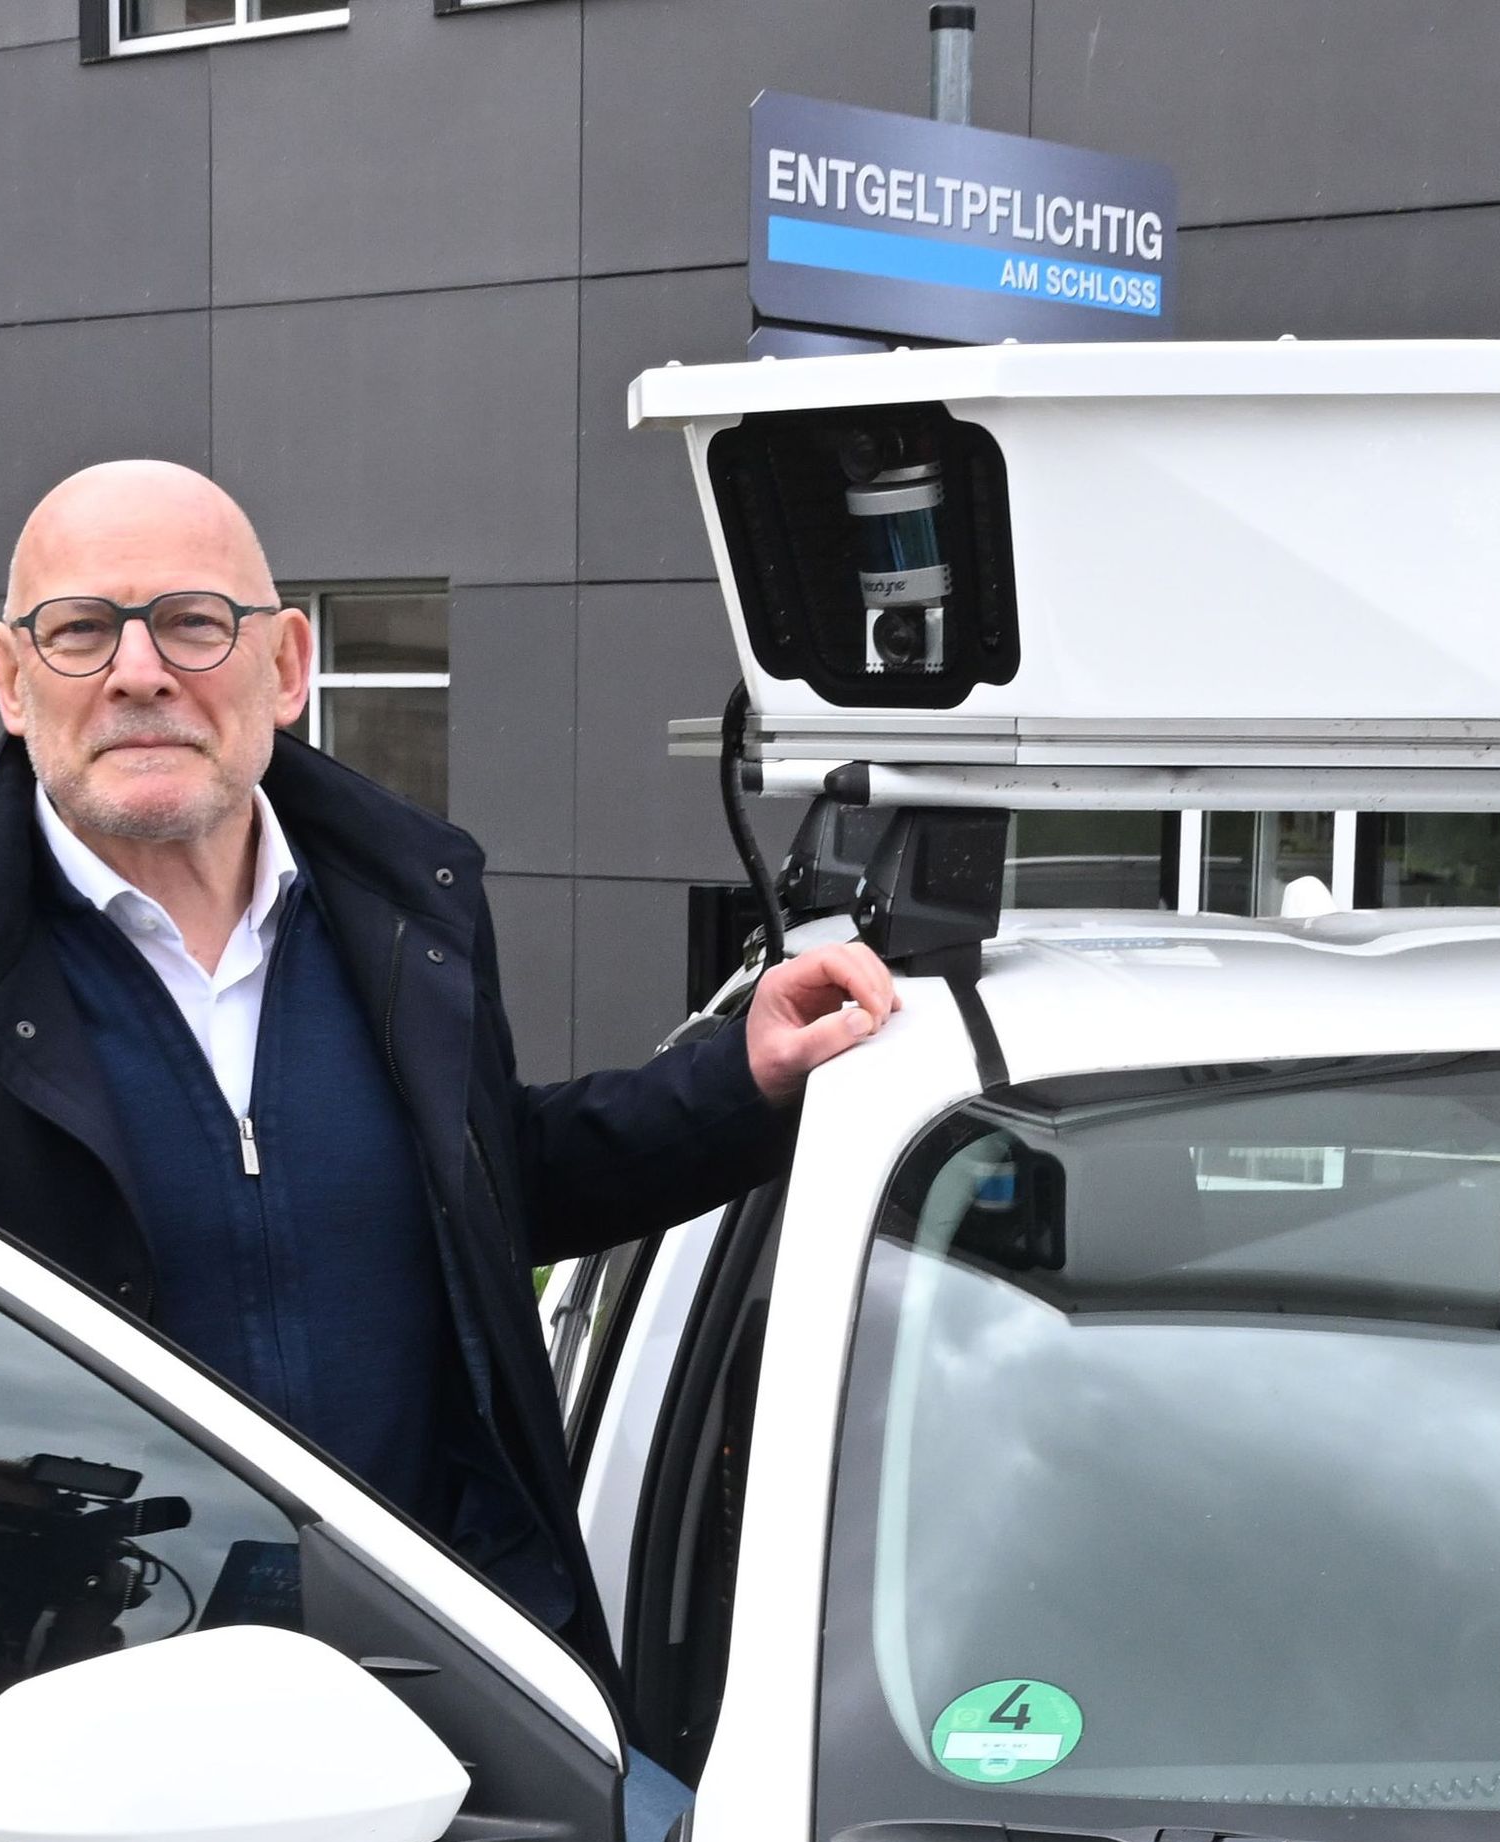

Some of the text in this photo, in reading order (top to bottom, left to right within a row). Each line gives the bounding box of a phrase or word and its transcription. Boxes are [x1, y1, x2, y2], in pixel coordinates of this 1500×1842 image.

[768, 148, 1163, 262] ENTGELTPFLICHTIG
[1000, 258, 1157, 310] AM SCHLOSS
[988, 1683, 1031, 1731] 4
